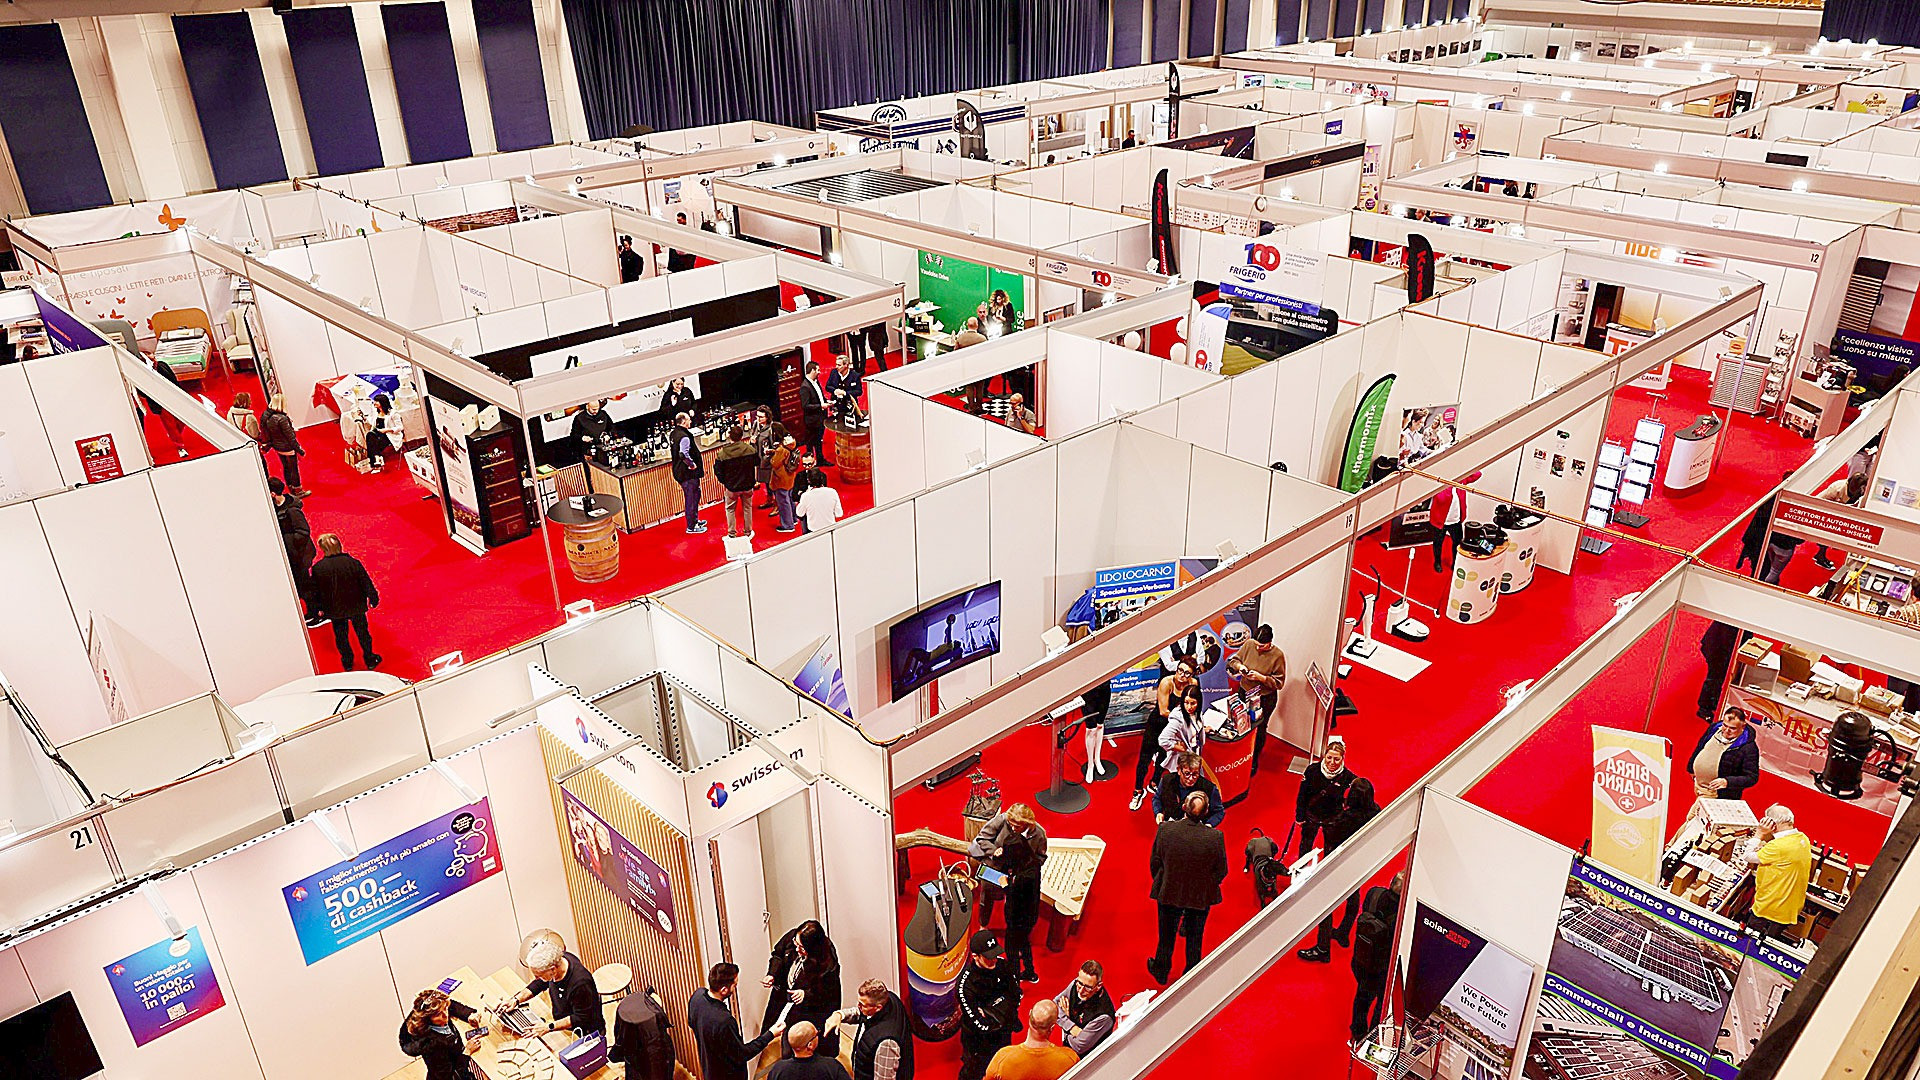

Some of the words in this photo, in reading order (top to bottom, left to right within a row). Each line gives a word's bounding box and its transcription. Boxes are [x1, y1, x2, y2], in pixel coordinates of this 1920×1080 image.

[1046, 262, 1068, 272] FRIGERIO
[1244, 243, 1281, 271] 100
[1810, 253, 1820, 264] 12
[1229, 265, 1266, 280] FRIGERIO
[893, 298, 901, 309] 43
[1234, 286, 1255, 298] Partner
[1255, 292, 1265, 301] per
[1265, 293, 1304, 309] professionisti
[1282, 317, 1298, 327] guida
[1299, 321, 1328, 333] satellitare
[1291, 311, 1297, 319] al
[1298, 312, 1329, 325] centimetro
[1841, 335, 1886, 351] Eccellenza
[1887, 344, 1915, 357] visiva.
[1842, 345, 1866, 356] uono
[1866, 350, 1877, 358] su
[1878, 351, 1912, 365] misura.
[1641, 375, 1662, 383] CAMINI
[1351, 404, 1377, 474] thermomix
[1345, 514, 1353, 529] 19
[1783, 512, 1813, 525] SVIZZERA
[1813, 520, 1841, 532] ITALIANA
[1846, 529, 1873, 541] INSIEME
[1788, 507, 1821, 520] SCRITTORI
[1826, 517, 1850, 528] AUTORI
[1850, 523, 1870, 534] DELLA
[1100, 572, 1122, 583] LIDO
[1122, 566, 1172, 581] LOCARNO
[1100, 587, 1127, 597] Speciale
[731, 747, 804, 792] swisscm
[1215, 763, 1232, 773] LIDO
[70, 826, 93, 850] 21
[318, 880, 324, 888] Il
[324, 868, 353, 887] miglior
[353, 854, 385, 873] Internet
[384, 851, 391, 859] e
[320, 865, 378, 895] l'abbonamento
[377, 858, 390, 869] TV
[389, 854, 399, 864] M
[399, 847, 412, 861] più
[411, 838, 436, 856] amato
[436, 831, 450, 845] con
[330, 913, 347, 929] di
[349, 879, 418, 920] cashback
[1580, 866, 1663, 910] Fotovoltaico
[1666, 906, 1675, 916] e
[1678, 910, 1739, 943] Batterie
[133, 974, 153, 987] Buoni
[153, 965, 175, 980] viaggio
[175, 958, 190, 971] per
[134, 984, 145, 993] un
[145, 976, 165, 989] valore
[164, 968, 185, 981] totale
[184, 962, 192, 972] di
[140, 987, 158, 1003] 10
[144, 999, 160, 1010] in
[160, 979, 196, 1006] palio!
[959, 970, 975, 1018] PERFORMANCE
[1462, 984, 1478, 999] We
[1479, 995, 1509, 1019] Power
[1460, 995, 1476, 1010] the
[1477, 1005, 1507, 1030] Future
[1546, 977, 1624, 1024] Commerciali
[1626, 1020, 1636, 1029] e
[1638, 1024, 1708, 1066] Industriali
[974, 1019, 989, 1031] PEAK
